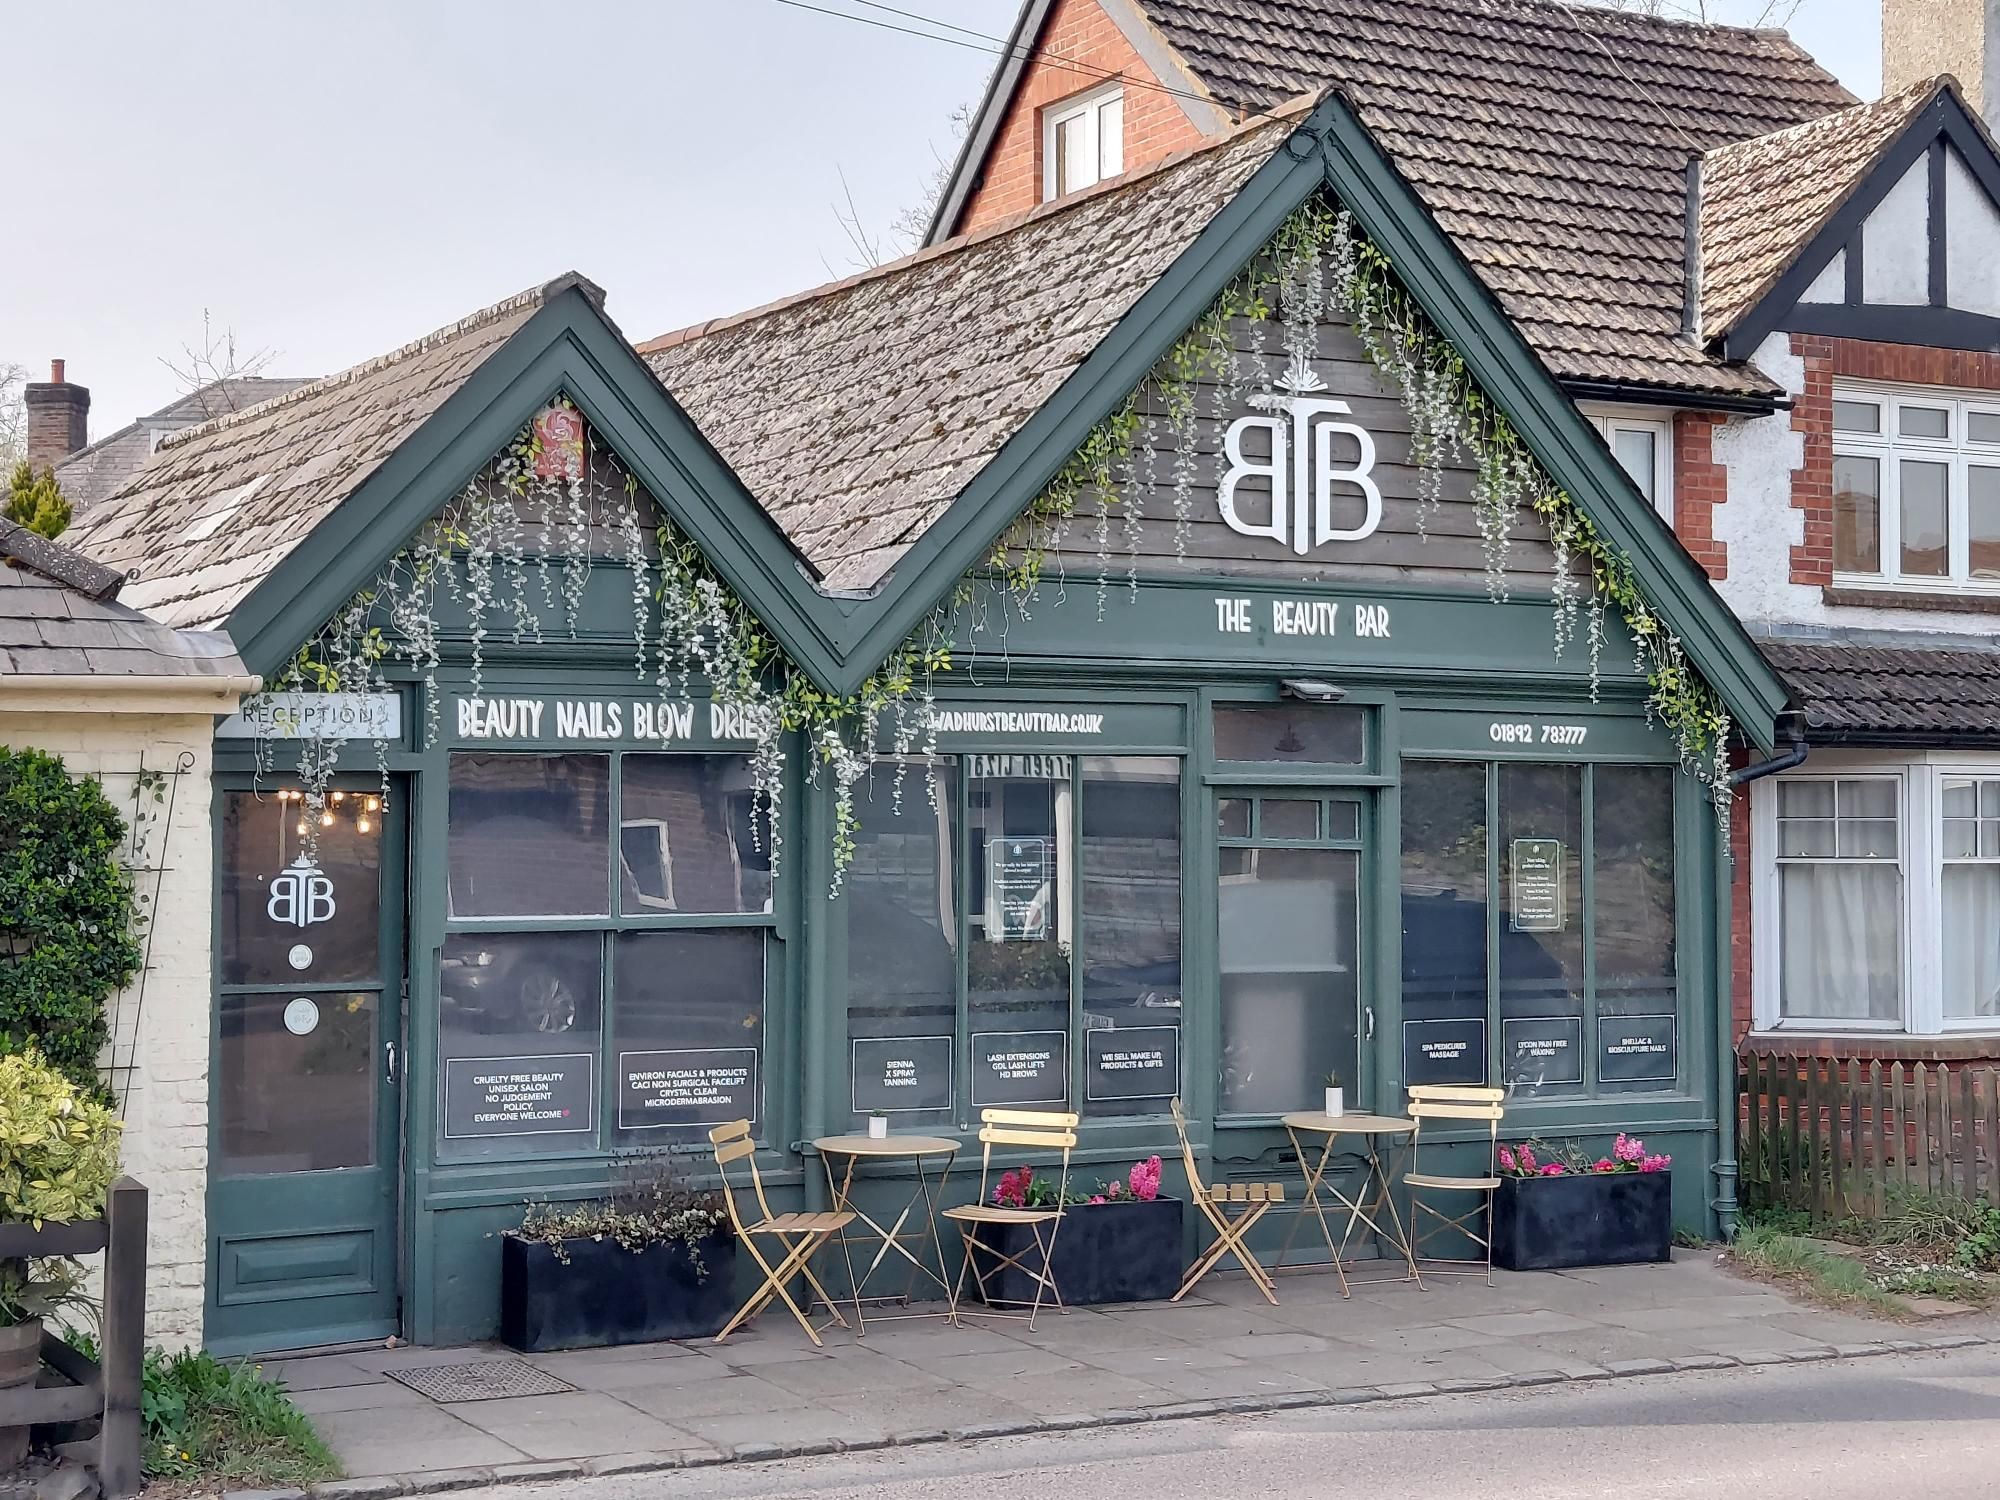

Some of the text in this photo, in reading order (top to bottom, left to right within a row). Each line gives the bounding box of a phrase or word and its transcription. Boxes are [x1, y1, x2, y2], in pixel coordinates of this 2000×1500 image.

[1215, 598, 1391, 638] THE BEAUTY BAR
[243, 706, 373, 724] RECEPTION
[457, 698, 772, 740] BEAUTY NAILS BLOW DRIE
[1489, 723, 1587, 744] 01892 783777
[987, 1052, 1050, 1062] LASH EXTENSIONS
[1130, 1052, 1150, 1060] MAKE
[886, 1060, 915, 1068] SIENNA
[1008, 1062, 1026, 1070] LASH
[1028, 1060, 1045, 1068] LIFTS
[1100, 1061, 1137, 1070] PRODUCTS
[1144, 1060, 1163, 1068] GIFTS
[474, 1073, 564, 1084] CRUELTY FREE BEAUTY
[629, 1068, 748, 1080] ENVIRON FACIALS & PRODUCTS
[886, 1069, 916, 1078] X SPRAY
[1000, 1070, 1038, 1079] HD BROWS
[632, 1078, 745, 1089] CACI NON SURGICAL FACELIFT
[883, 1078, 918, 1086] TANNING
[488, 1083, 549, 1093] UNISEX SALON
[660, 1088, 718, 1098] CRYSTAL CLEAR
[485, 1092, 552, 1102] NO JUDGEMENT
[644, 1096, 732, 1107] MICRODERMABRASION
[474, 1110, 562, 1122] EVERYONE WELCOME
